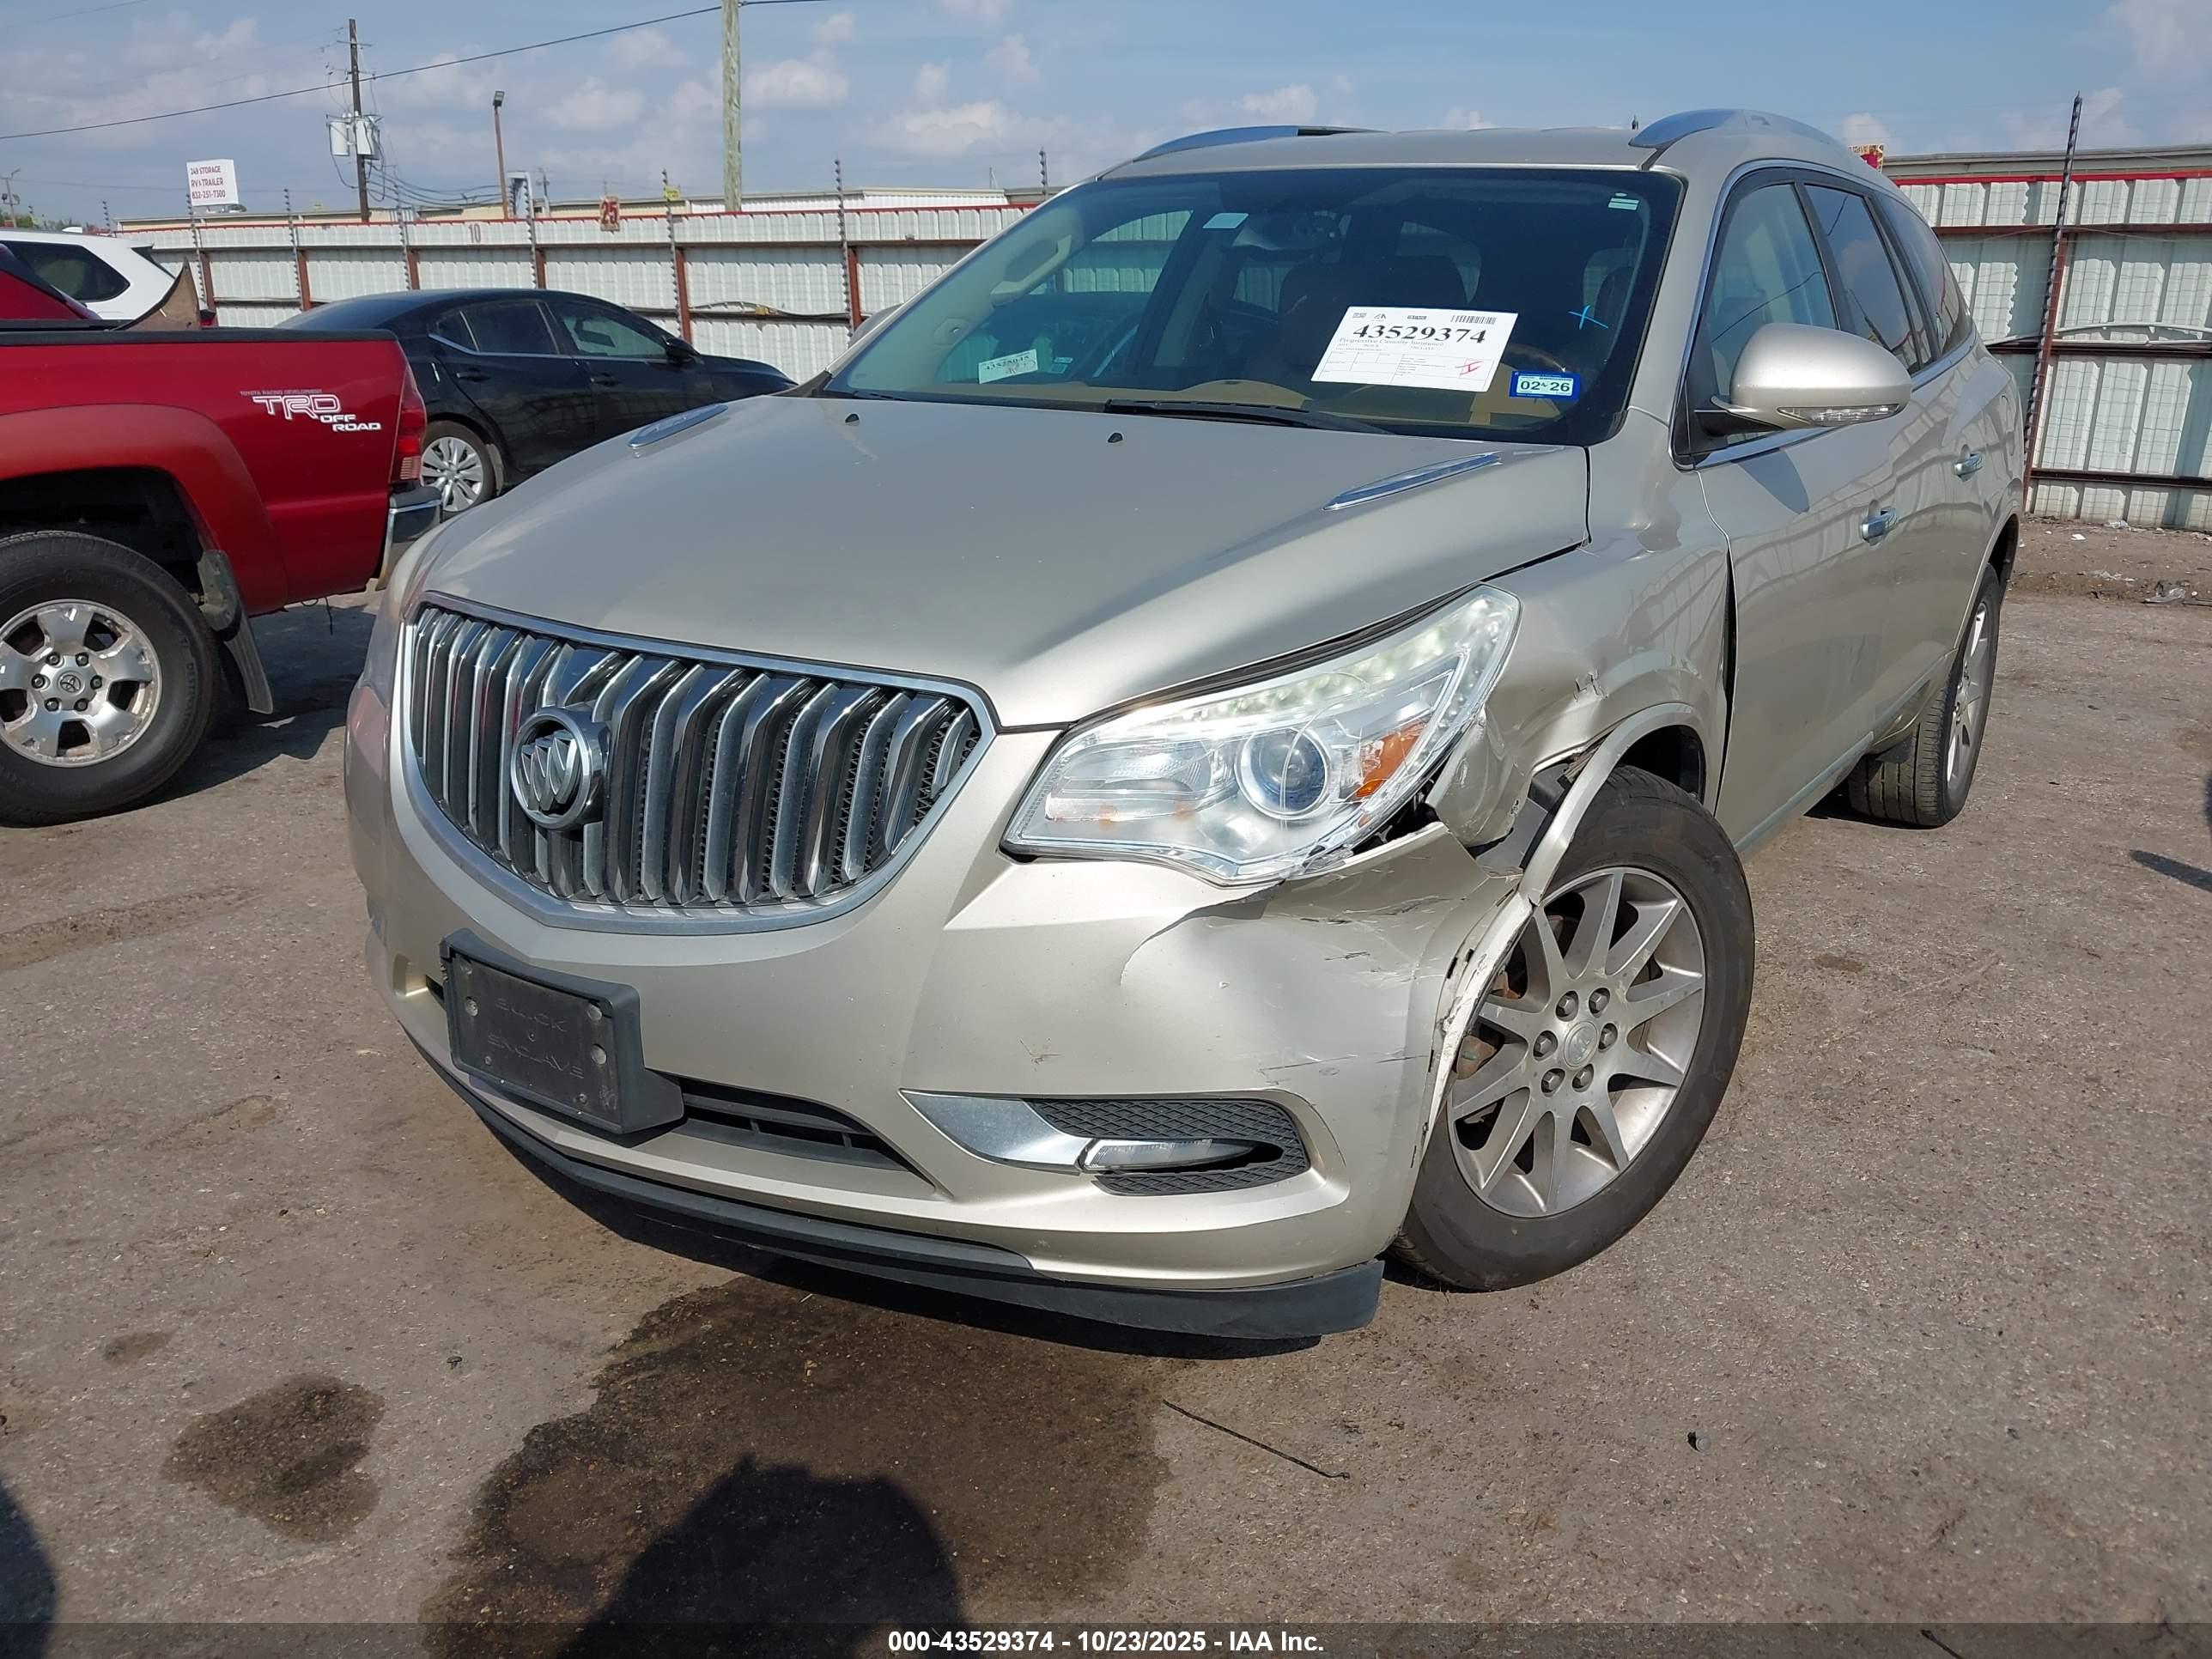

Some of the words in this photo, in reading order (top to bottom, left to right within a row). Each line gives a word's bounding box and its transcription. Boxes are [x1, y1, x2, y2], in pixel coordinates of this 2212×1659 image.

[199, 166, 221, 174] STORAGE
[191, 179, 198, 187] RV
[202, 178, 223, 186] TRAILER
[468, 223, 481, 243] 10
[1352, 324, 1487, 344] 43529374
[1520, 380, 1540, 391] 02
[1549, 381, 1571, 392] 26
[252, 394, 342, 421] TRD
[319, 414, 356, 423] OFF
[332, 422, 381, 432] ROAD
[487, 1033, 586, 1080] ENCLAVE
